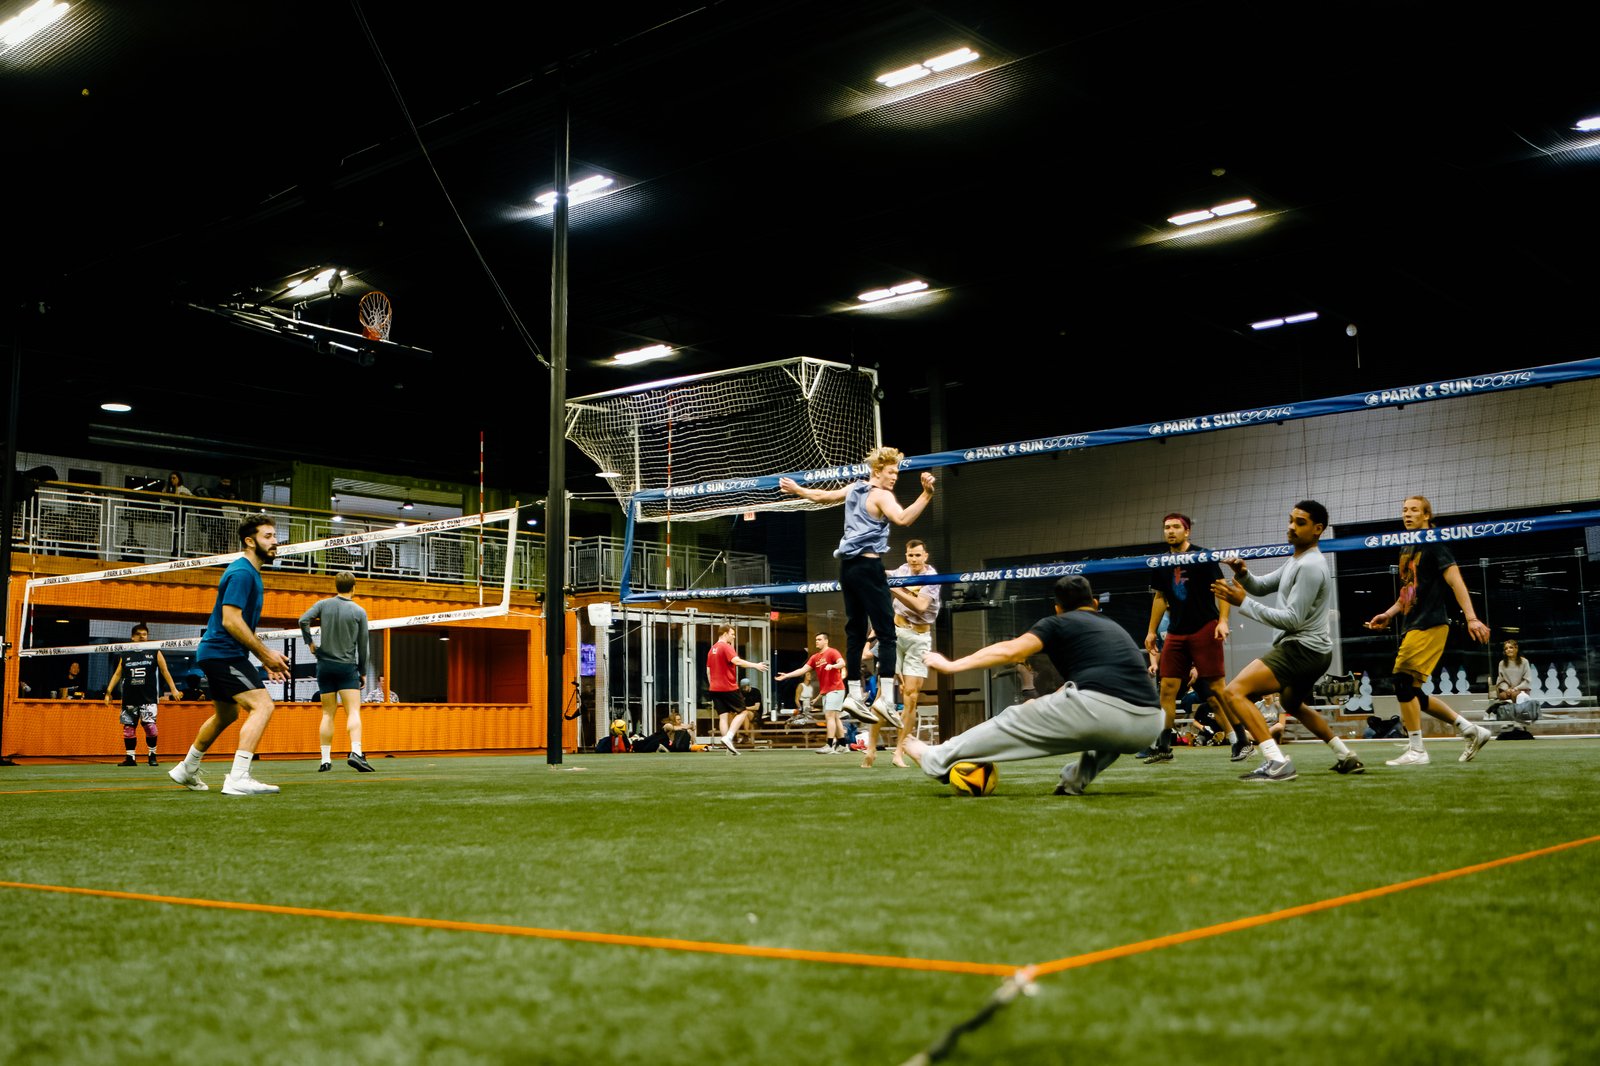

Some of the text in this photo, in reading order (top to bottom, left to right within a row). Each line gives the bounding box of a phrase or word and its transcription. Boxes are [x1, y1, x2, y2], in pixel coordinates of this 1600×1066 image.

[1381, 386, 1421, 404] PARK
[1425, 384, 1437, 398] &
[1163, 418, 1198, 434] PARK
[1200, 417, 1211, 429] &
[976, 445, 1006, 459] PARK
[1008, 444, 1017, 455] &
[814, 468, 840, 480] PARK
[842, 467, 850, 477] &
[673, 485, 696, 496] PARK
[698, 484, 704, 494] &
[330, 538, 345, 546] PARK
[1381, 530, 1421, 547] PARK
[1426, 528, 1437, 542] &
[173, 561, 186, 569] PARK
[1160, 553, 1196, 567] PARK
[1198, 551, 1208, 563] &
[971, 570, 1001, 582] PARK
[1004, 569, 1013, 580] &
[808, 582, 835, 593] PARK
[165, 640, 177, 648] PARK
[130, 667, 146, 677] 15
